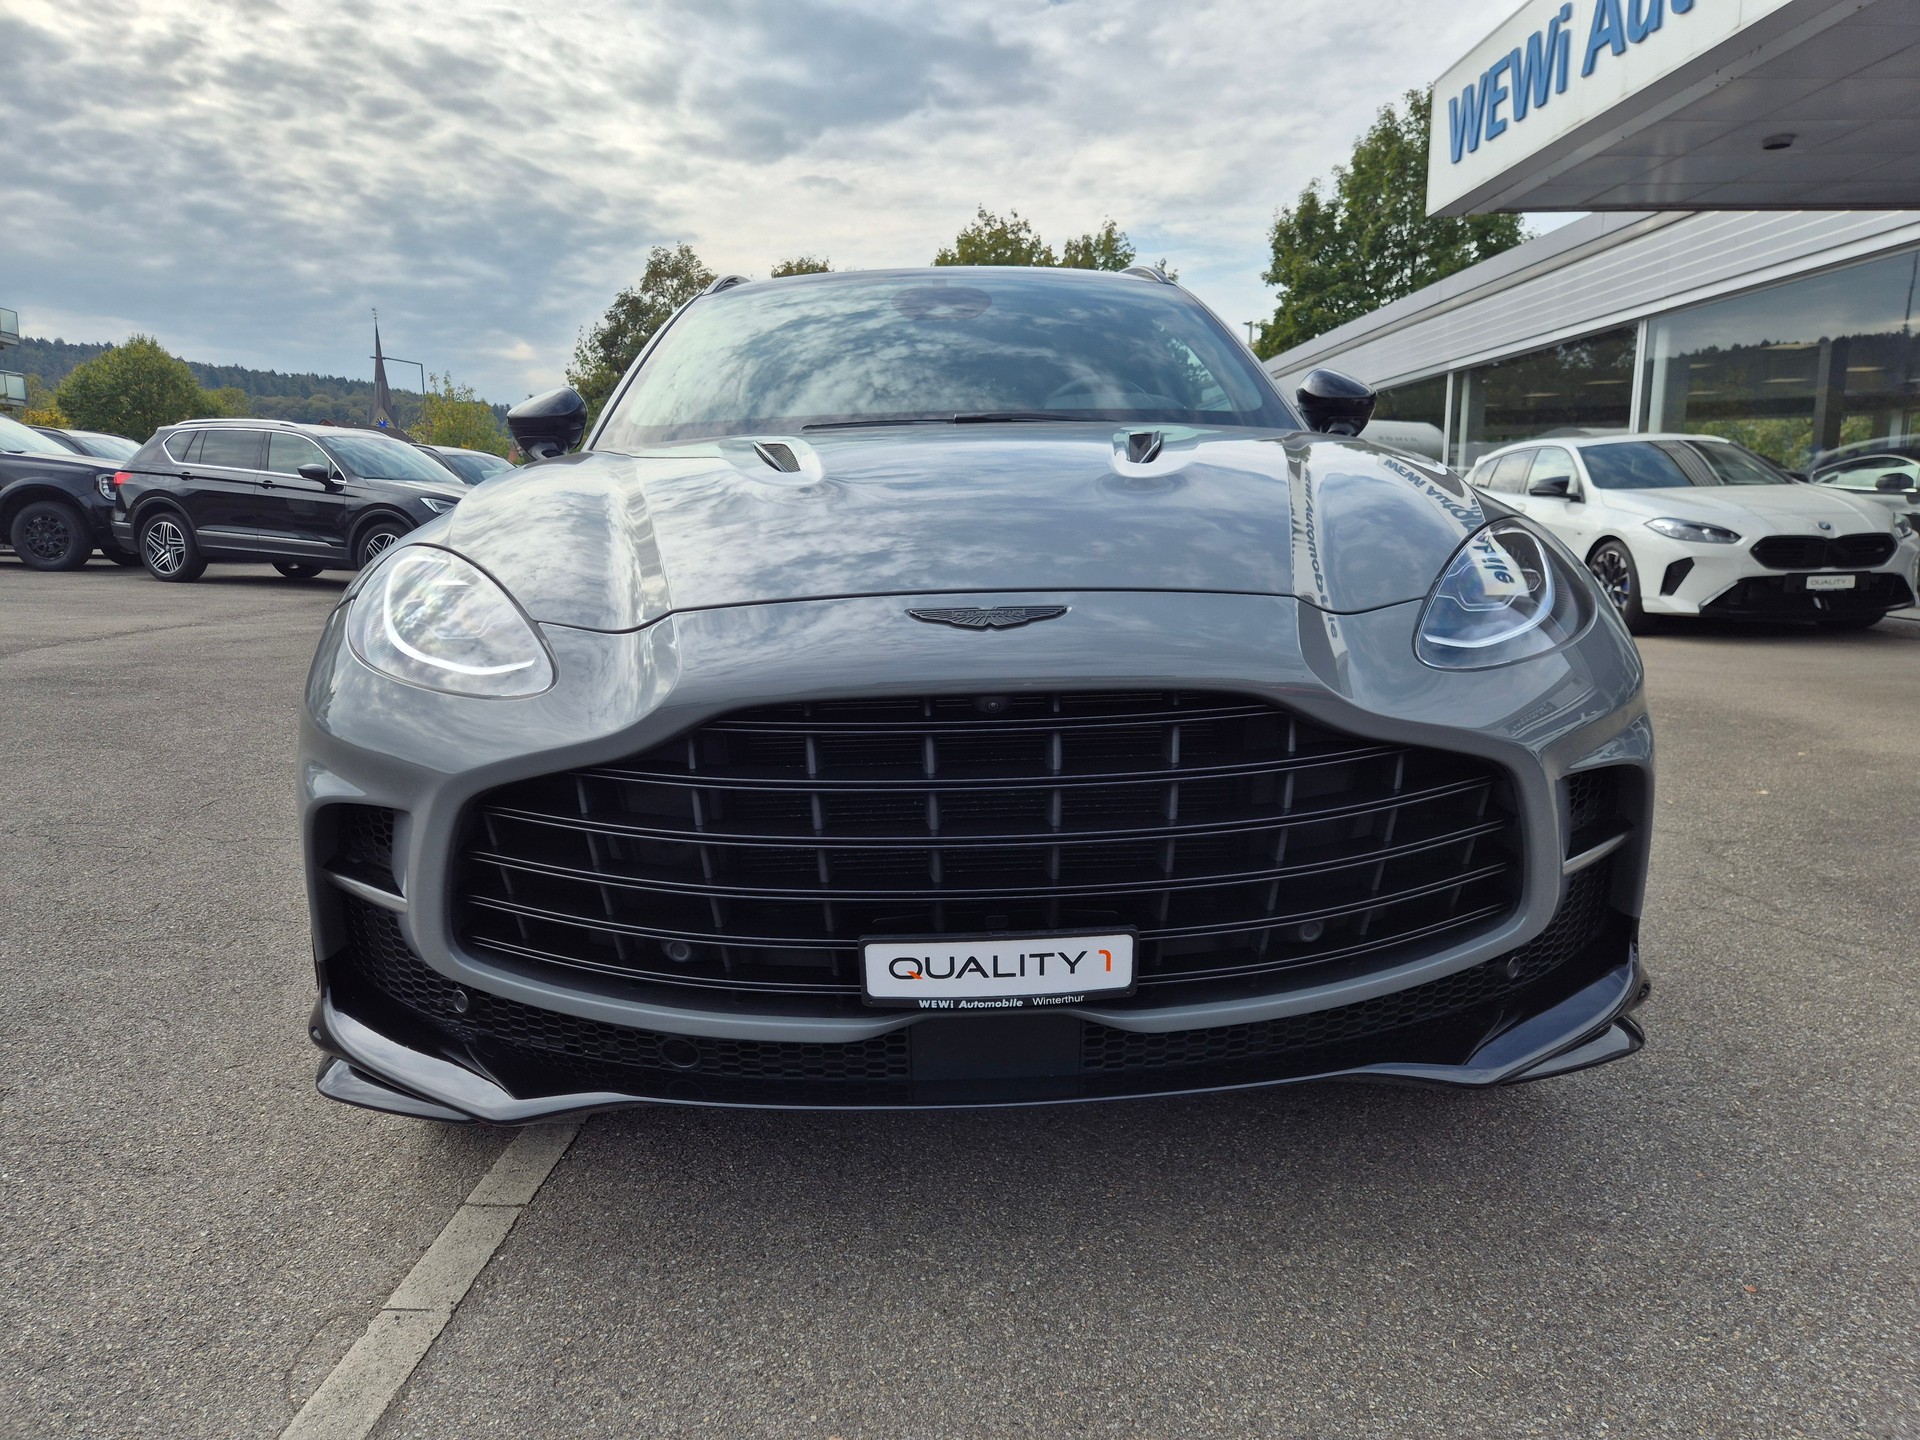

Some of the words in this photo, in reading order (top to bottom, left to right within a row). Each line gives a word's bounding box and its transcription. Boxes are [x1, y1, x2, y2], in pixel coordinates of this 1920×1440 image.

[1448, 2, 1572, 164] WEWi
[1581, 0, 1694, 78] Au
[888, 950, 1088, 980] QUALITY
[1098, 949, 1112, 972] 1
[918, 999, 954, 1009] WEWi
[958, 998, 1024, 1009] Automobile
[1032, 995, 1085, 1006] Winterthur
